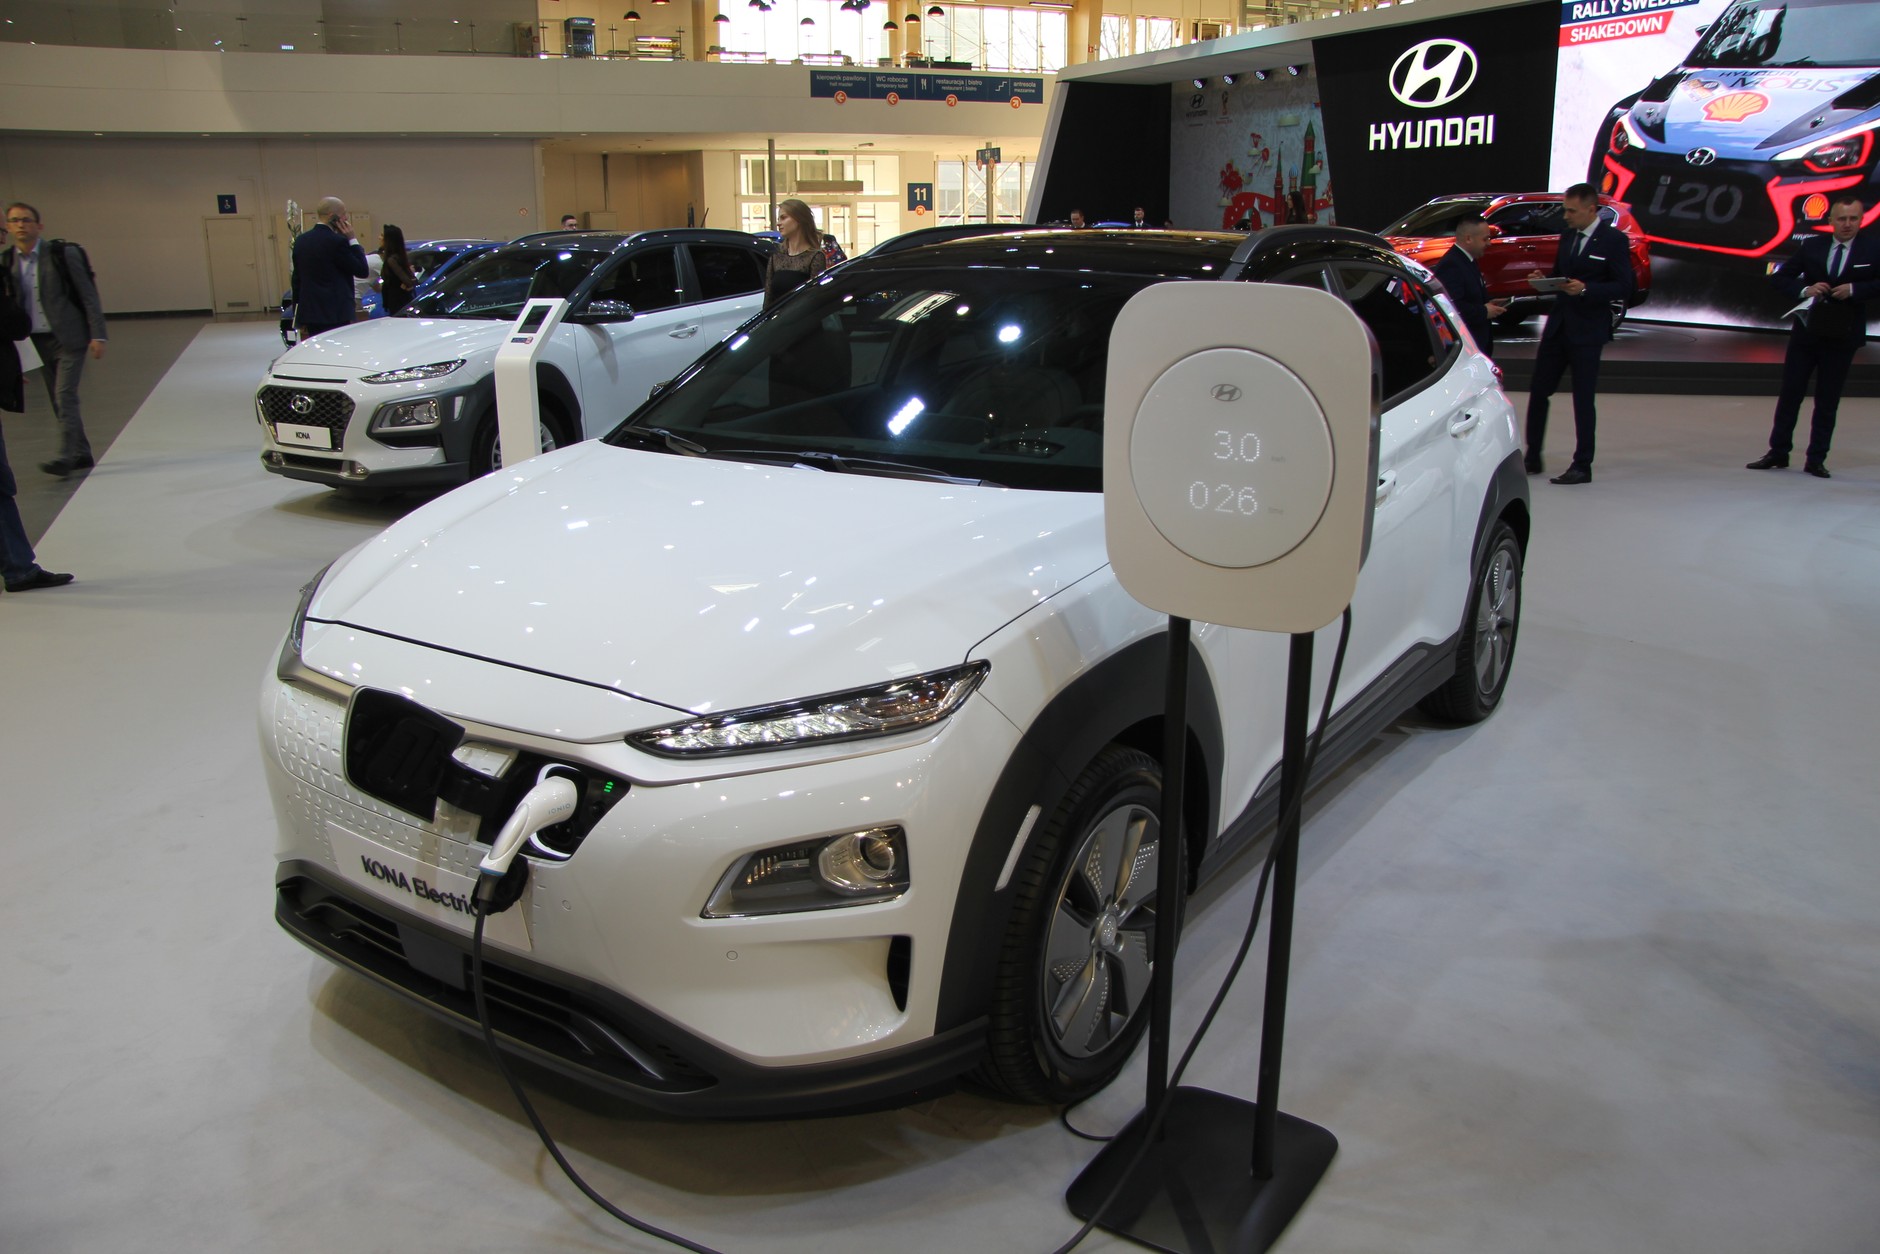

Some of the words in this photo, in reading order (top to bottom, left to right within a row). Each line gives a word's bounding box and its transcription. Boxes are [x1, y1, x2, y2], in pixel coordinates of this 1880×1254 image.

[1572, 0, 1620, 20] RALLY
[1570, 16, 1663, 43] SHAKEDOWN
[1729, 77, 1846, 93] MOBIS
[1369, 114, 1495, 151] HYUNDAI
[914, 187, 927, 201] 11
[1649, 175, 1744, 225] i20
[295, 431, 311, 440] KONA
[1214, 430, 1261, 462] 3.0
[361, 855, 412, 893] KONA
